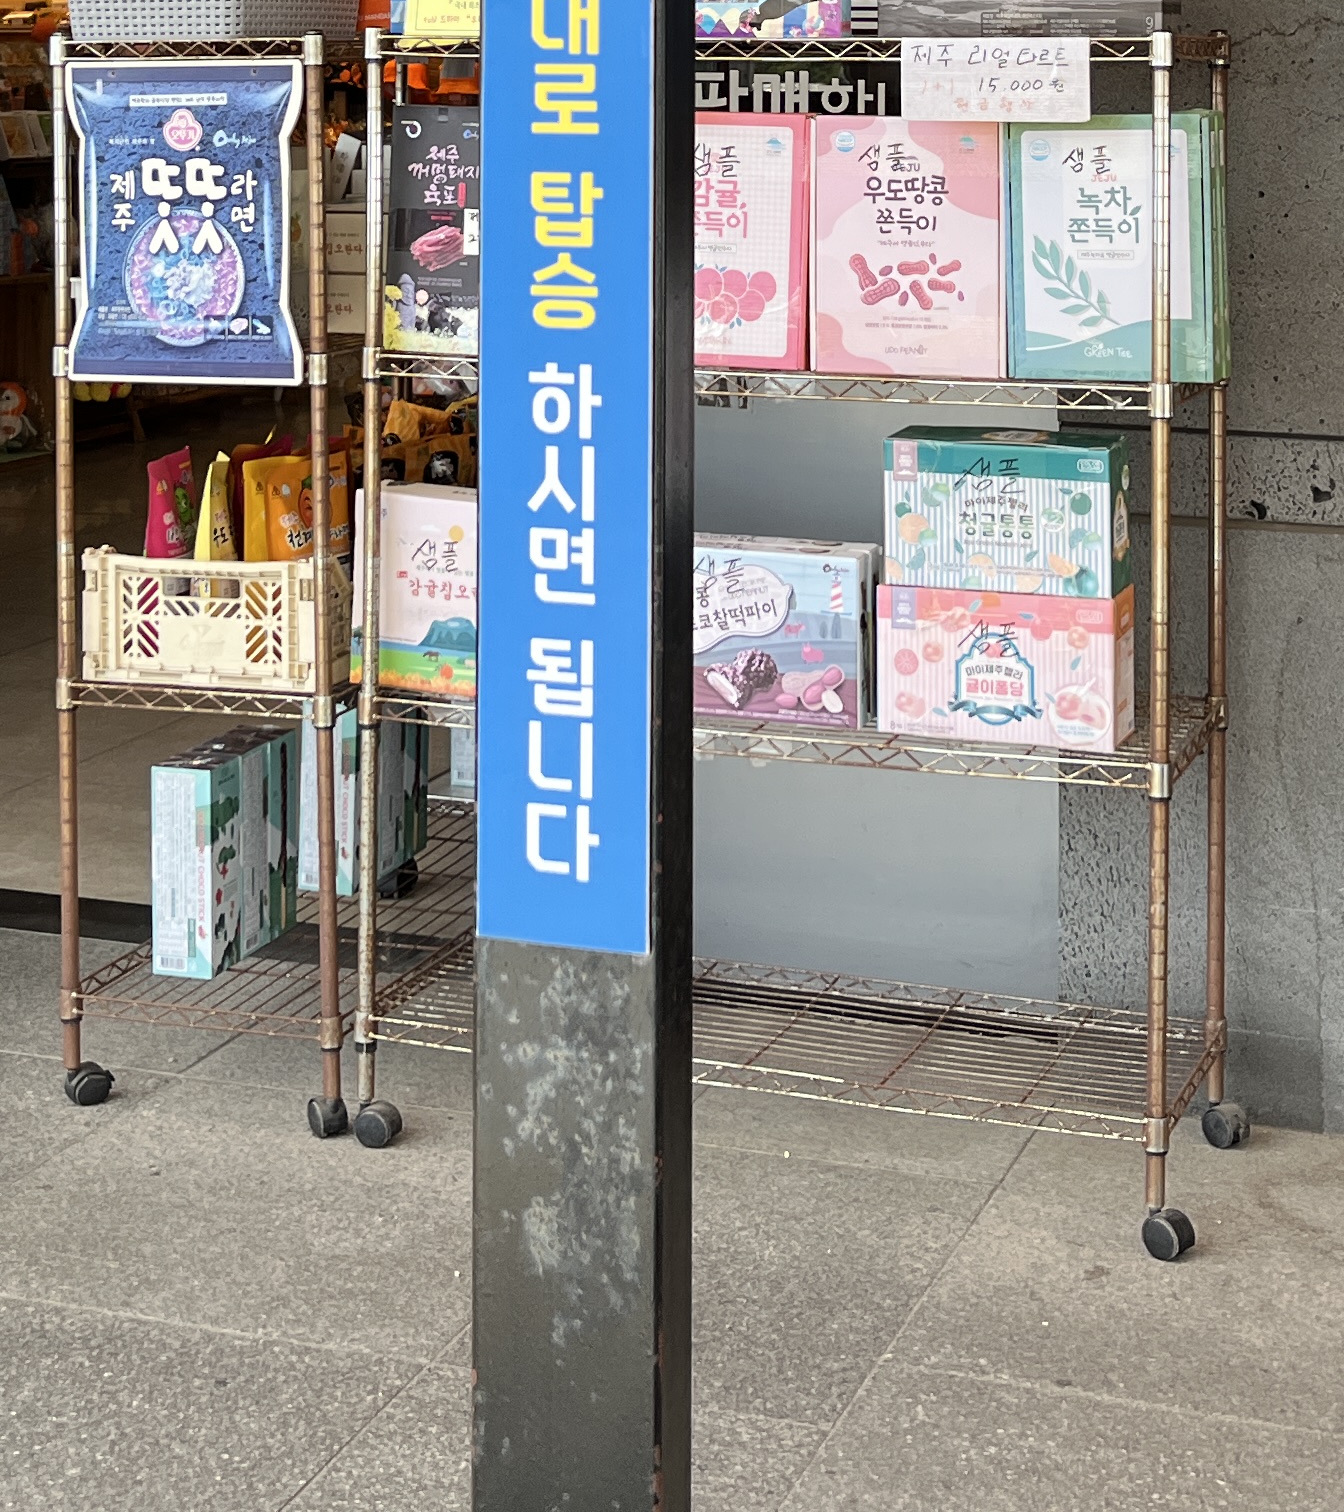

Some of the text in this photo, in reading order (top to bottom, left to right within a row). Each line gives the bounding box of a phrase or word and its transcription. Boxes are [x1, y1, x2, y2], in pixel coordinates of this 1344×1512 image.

[911, 44, 955, 68] 제주
[922, 78, 954, 95] 1+1
[425, 144, 460, 164] 제주
[858, 143, 910, 173] 샘플
[1062, 145, 1113, 175] 샘플
[863, 175, 950, 206] 우도땅콩
[1090, 174, 1117, 183] JEJU
[423, 184, 459, 206] 육포
[1076, 185, 1133, 216] 녹차
[875, 207, 937, 235] 쫀득이
[1066, 217, 1140, 244] 쫀득이
[529, 171, 603, 329] 탑승
[527, 362, 602, 606] 하시면
[954, 456, 1026, 495] 샘플
[411, 538, 459, 573] 샘플
[693, 554, 745, 595] 샘플
[693, 598, 778, 631] 코찰떡파이
[957, 619, 1019, 659] 샘플
[526, 638, 600, 883] 됩니다
